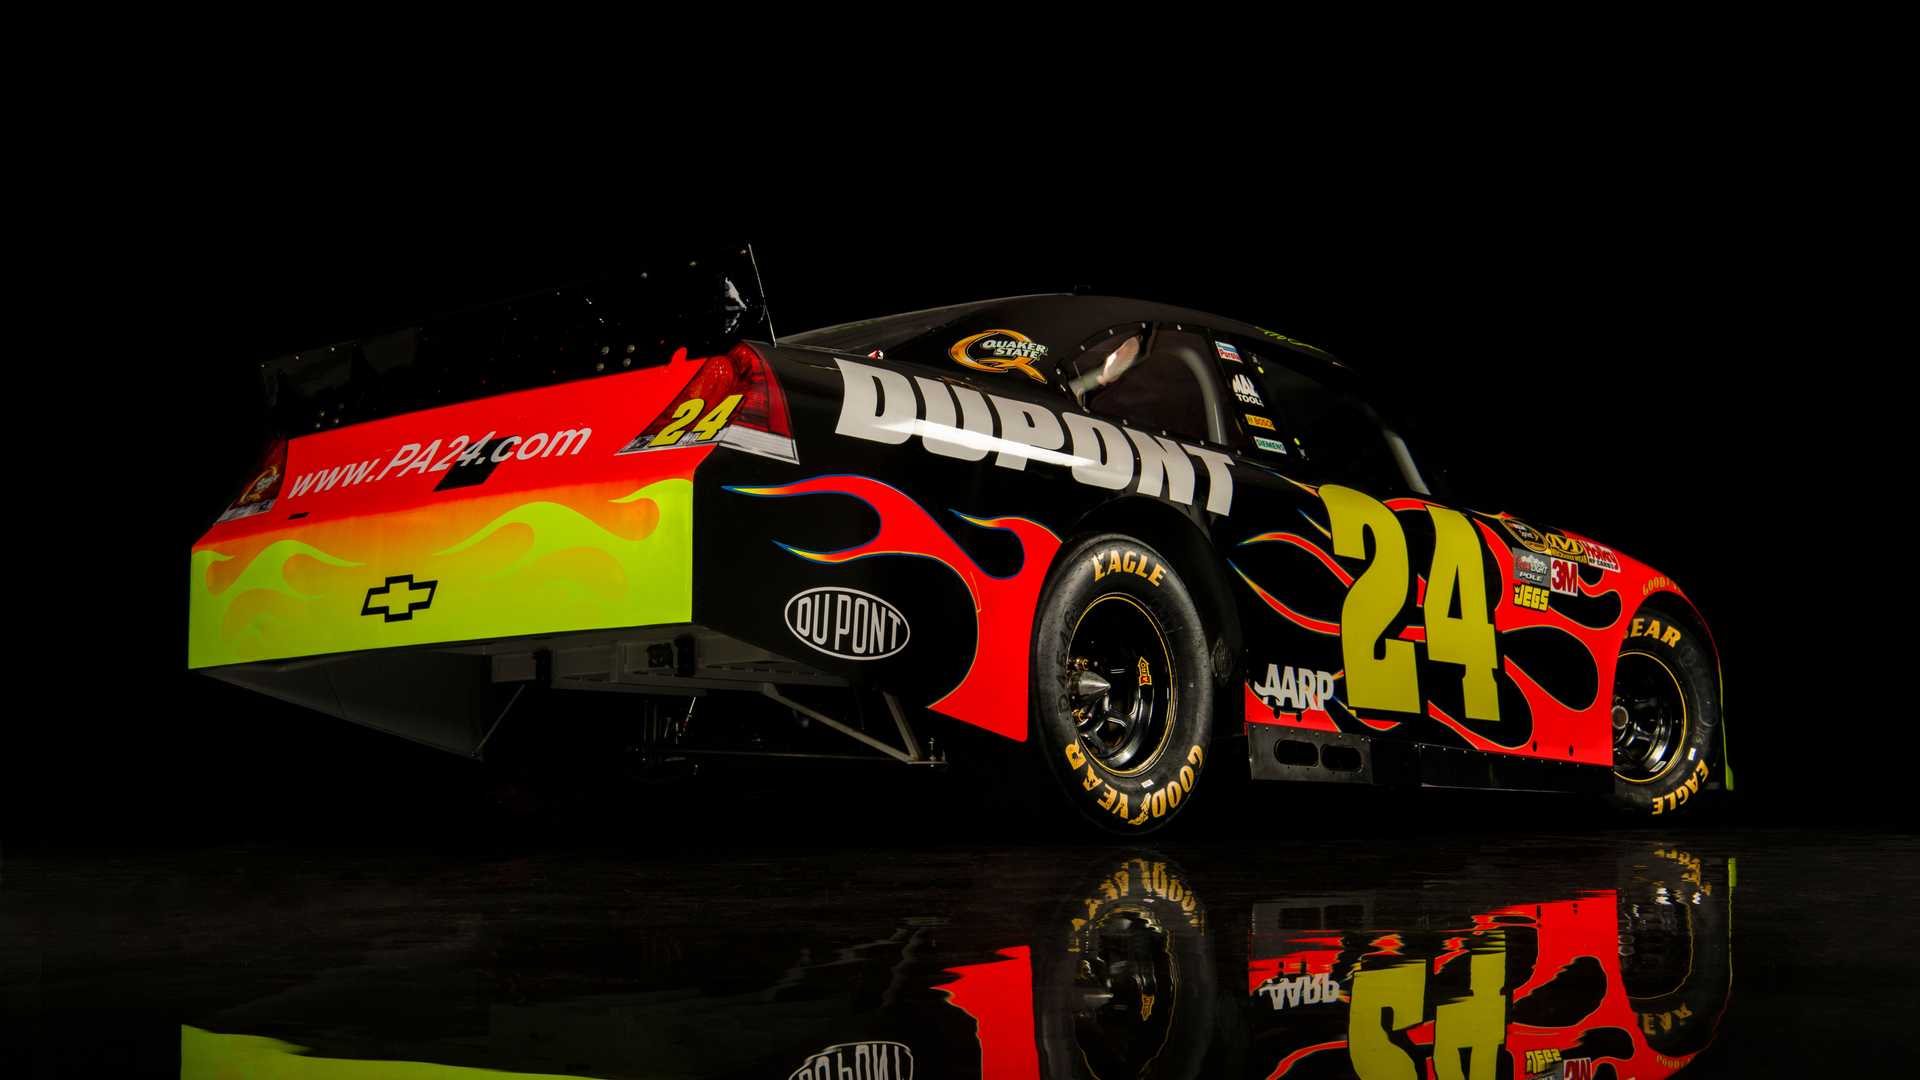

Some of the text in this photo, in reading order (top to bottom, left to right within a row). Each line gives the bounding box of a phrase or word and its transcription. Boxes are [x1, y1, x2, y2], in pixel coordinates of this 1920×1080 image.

[982, 339, 1046, 354] QUAKER
[994, 347, 1040, 360] STATE
[648, 394, 744, 448] 24
[834, 357, 1235, 517] DUPONT
[287, 426, 593, 500] www.PA24.com
[1091, 550, 1167, 588] EAGLE
[1519, 570, 1543, 582] POLE
[1551, 559, 1577, 593] 3M
[1642, 575, 1682, 597] GOOD
[1317, 483, 1501, 722] 24
[1513, 584, 1550, 611] JEGS
[1624, 617, 1682, 649] EAR
[1254, 663, 1335, 711] AARP
[1065, 738, 1203, 826] GOODYEAR
[1652, 759, 1710, 816] EAGLE
